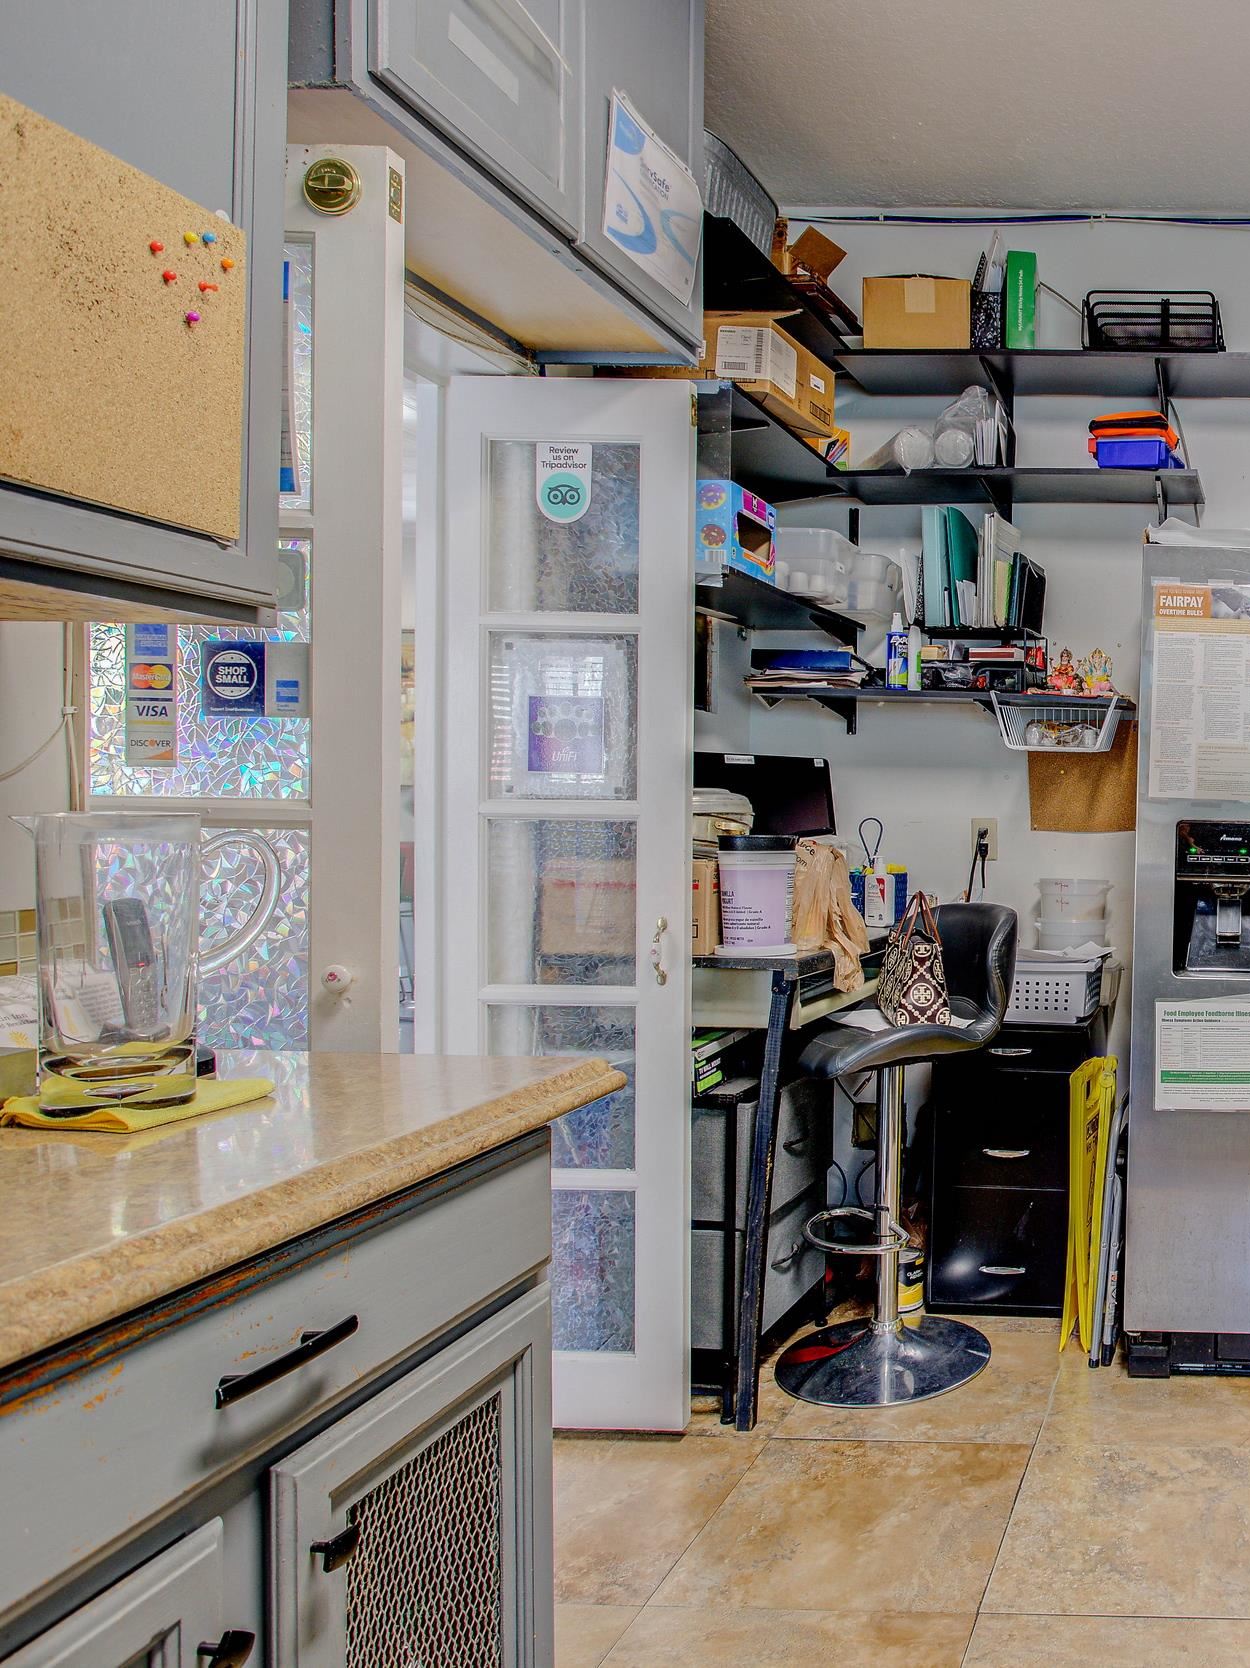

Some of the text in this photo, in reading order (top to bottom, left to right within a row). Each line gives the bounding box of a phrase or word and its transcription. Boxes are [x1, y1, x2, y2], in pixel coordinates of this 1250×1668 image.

[541, 461, 587, 470] Tripadvisor
[1160, 595, 1204, 608] FAIRPAY
[218, 666, 246, 675] SHOP
[132, 672, 170, 682] MasterCard
[215, 675, 249, 684] SMALL
[136, 705, 168, 717] VISA
[553, 750, 577, 762] UniFi
